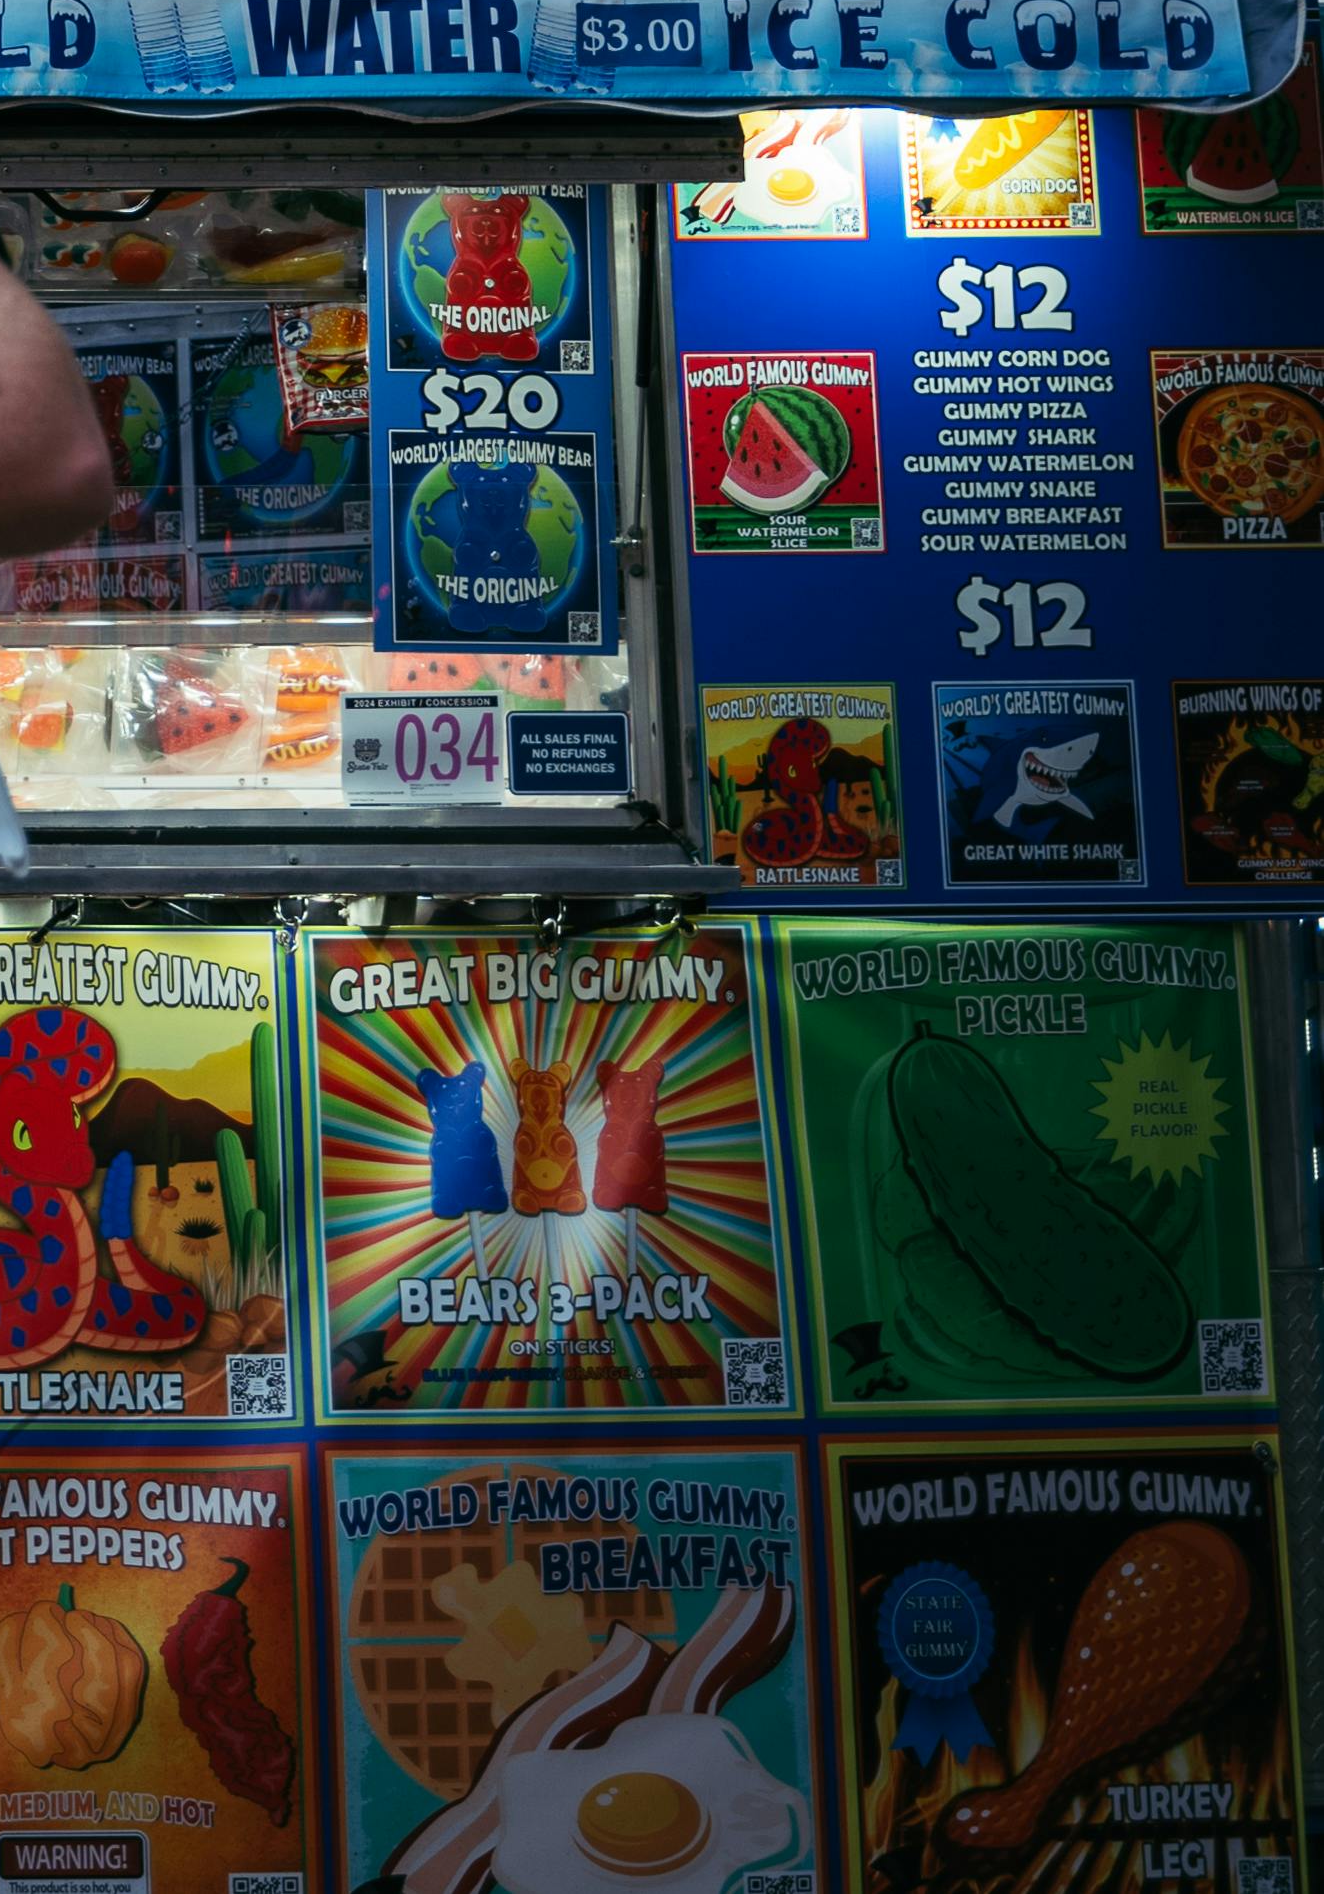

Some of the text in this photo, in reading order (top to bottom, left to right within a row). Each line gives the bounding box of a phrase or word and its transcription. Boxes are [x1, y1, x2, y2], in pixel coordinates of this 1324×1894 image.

[581, 12, 695, 58] $3.00
[938, 257, 1073, 336] $12
[914, 349, 1110, 368] GUMMY CORN DOG
[913, 375, 1114, 394] GUMMY HOT WINGS
[422, 368, 562, 433] $20
[943, 402, 1087, 420] GUMMY PIZZA
[938, 428, 1097, 446] GUMMY SHARK
[903, 454, 1134, 473] GUMMY WATERMELON
[945, 481, 1096, 499] GUMMY SNAKE
[921, 507, 1122, 525] GUMMY BREAKFAST
[921, 533, 1126, 552] SOUR WATERMELON
[956, 576, 1092, 656] $12
[353, 696, 491, 708] 2024 EXHIBIT CONCESSION
[394, 712, 499, 783] 034
[520, 733, 617, 744] ALL SALES FINAL
[532, 748, 607, 759] NO REFUNDS
[526, 762, 616, 773] NO EXCHANGES
[955, 994, 1089, 1037] PICKLE
[398, 1273, 713, 1326] BEARS 3-PACK
[25, 1526, 185, 1572] PEPPERS
[539, 1535, 793, 1595] BREAKFAST
[1106, 1783, 1234, 1823] TURKEY
[13, 1841, 129, 1873] WARNING!
[1142, 1837, 1209, 1882] LEG
